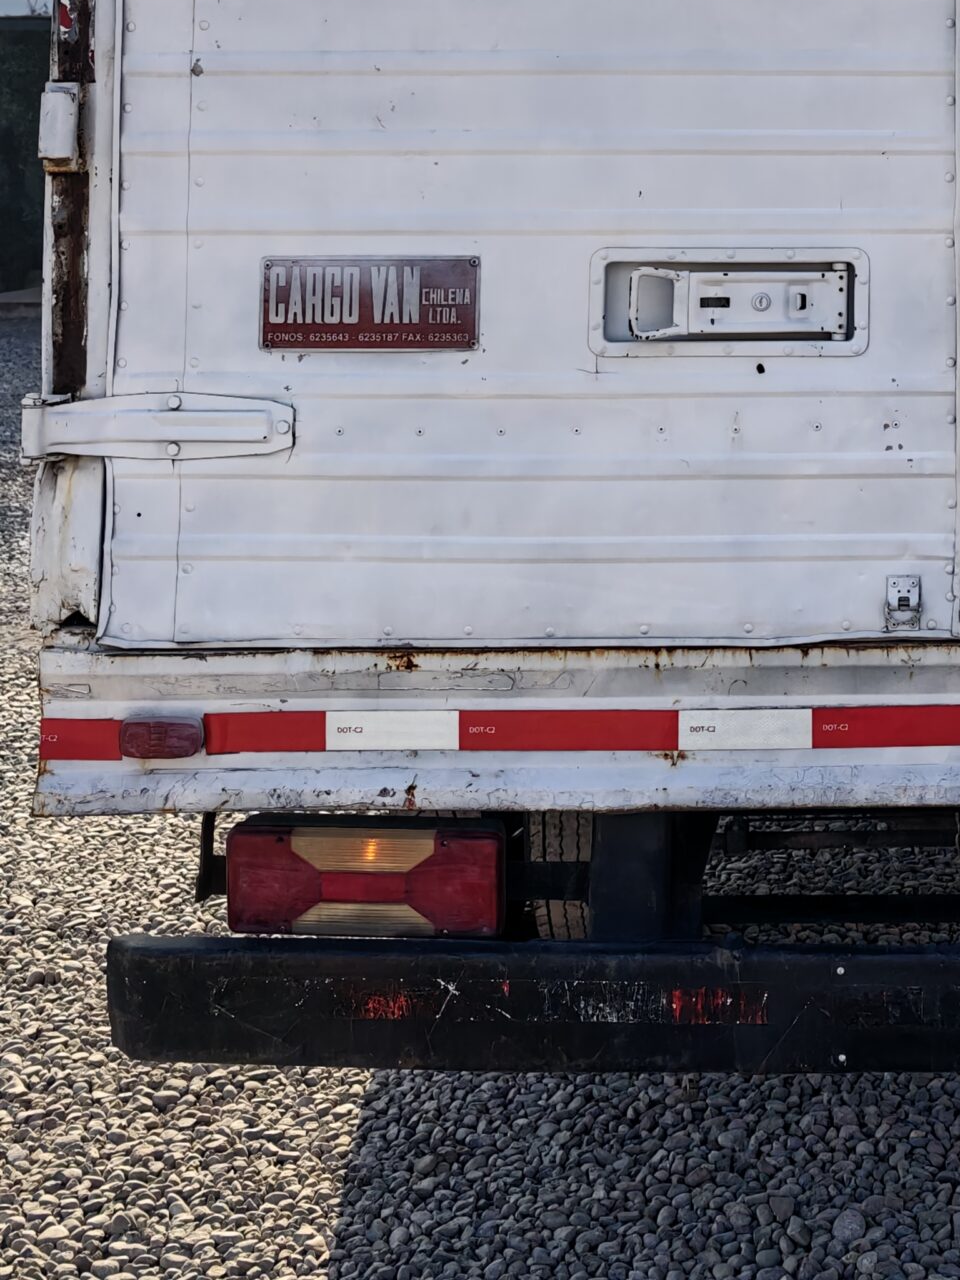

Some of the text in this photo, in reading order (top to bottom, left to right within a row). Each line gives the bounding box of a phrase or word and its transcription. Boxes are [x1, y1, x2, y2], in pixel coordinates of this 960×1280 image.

[268, 266, 421, 324] CARGO VAN
[421, 288, 471, 305] CHILENA
[428, 307, 462, 324] LTDA.
[267, 332, 306, 342] FONOS:
[309, 332, 349, 342] 6235643
[358, 332, 399, 342] 6235187
[402, 332, 425, 342] FAX:
[337, 726, 363, 734] DOT-C2
[469, 726, 495, 734] DOT-C2
[689, 725, 716, 733] DOT-C2
